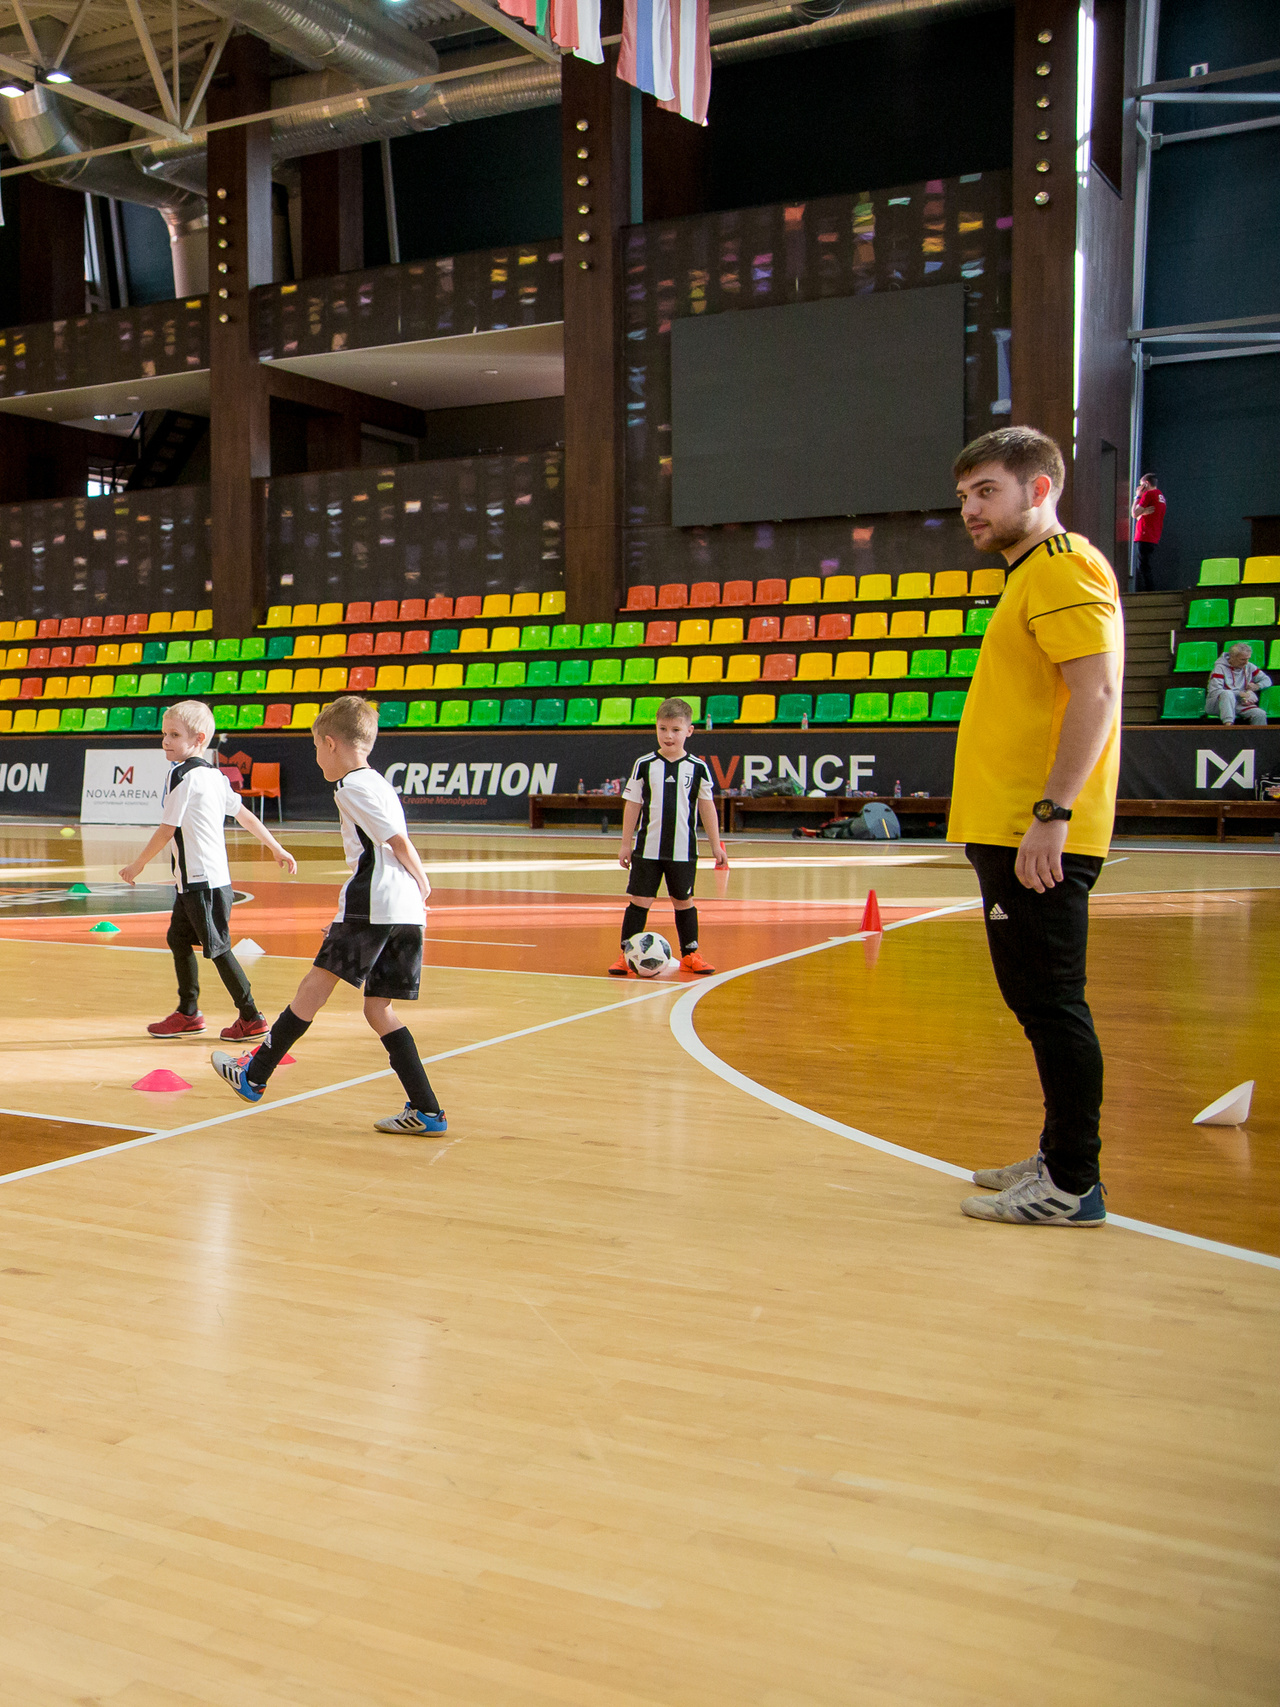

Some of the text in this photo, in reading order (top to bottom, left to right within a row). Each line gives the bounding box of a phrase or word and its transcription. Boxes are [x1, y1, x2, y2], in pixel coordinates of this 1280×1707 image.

[384, 762, 558, 797] CREATION
[698, 754, 876, 791] VRNCF
[86, 789, 158, 799] NOVA ARENA
[402, 795, 488, 807] Creatine Monohydrate
